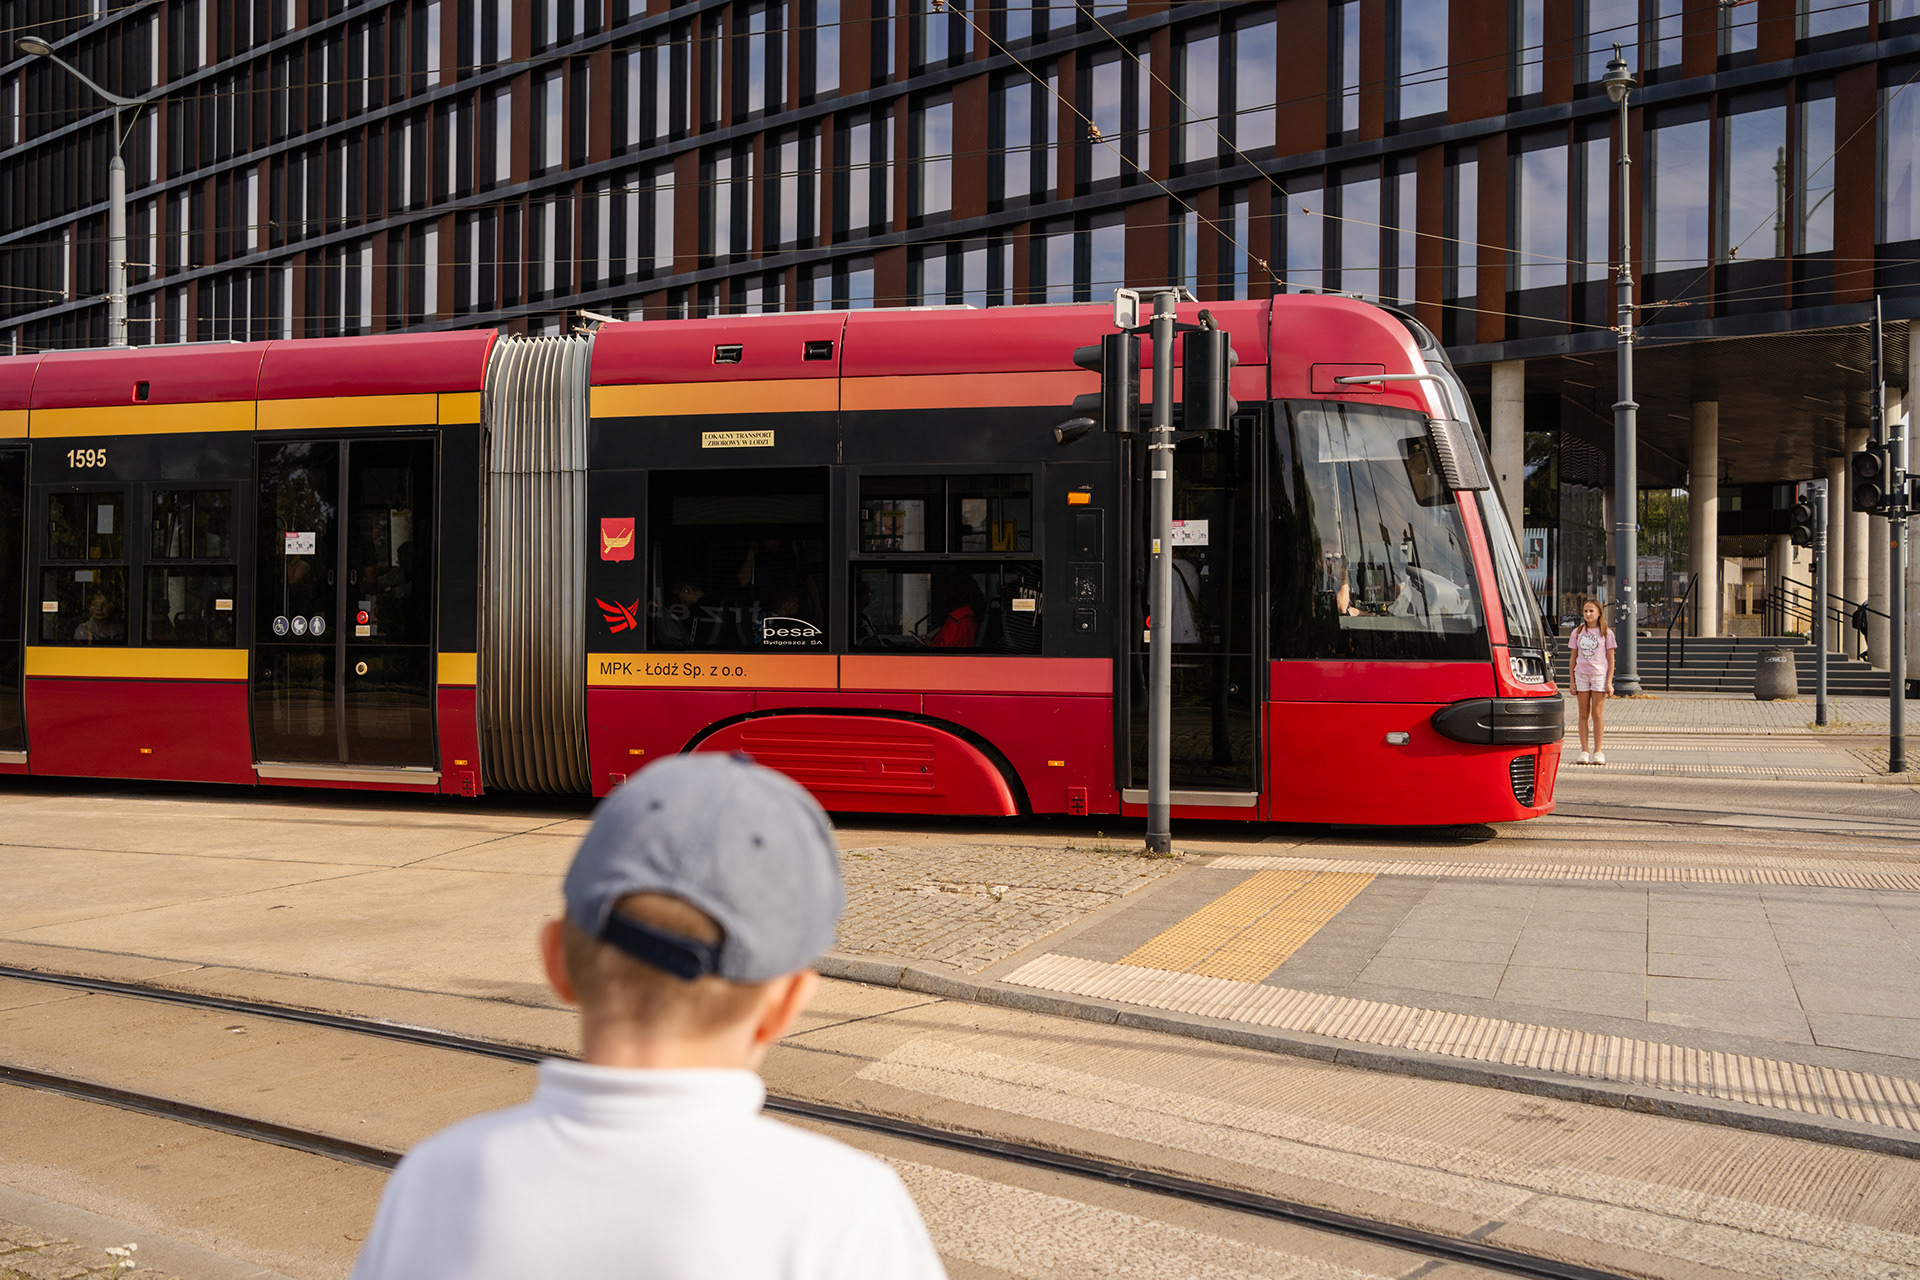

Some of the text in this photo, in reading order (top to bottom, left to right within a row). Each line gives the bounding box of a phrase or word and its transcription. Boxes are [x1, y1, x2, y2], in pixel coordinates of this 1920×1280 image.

[67, 448, 107, 468] 1595
[763, 628, 815, 639] pesa
[600, 662, 632, 675] MPK
[645, 662, 679, 676] Łódź
[683, 662, 705, 679] Sp.
[710, 666, 718, 677] z
[722, 666, 747, 677] o.o.
